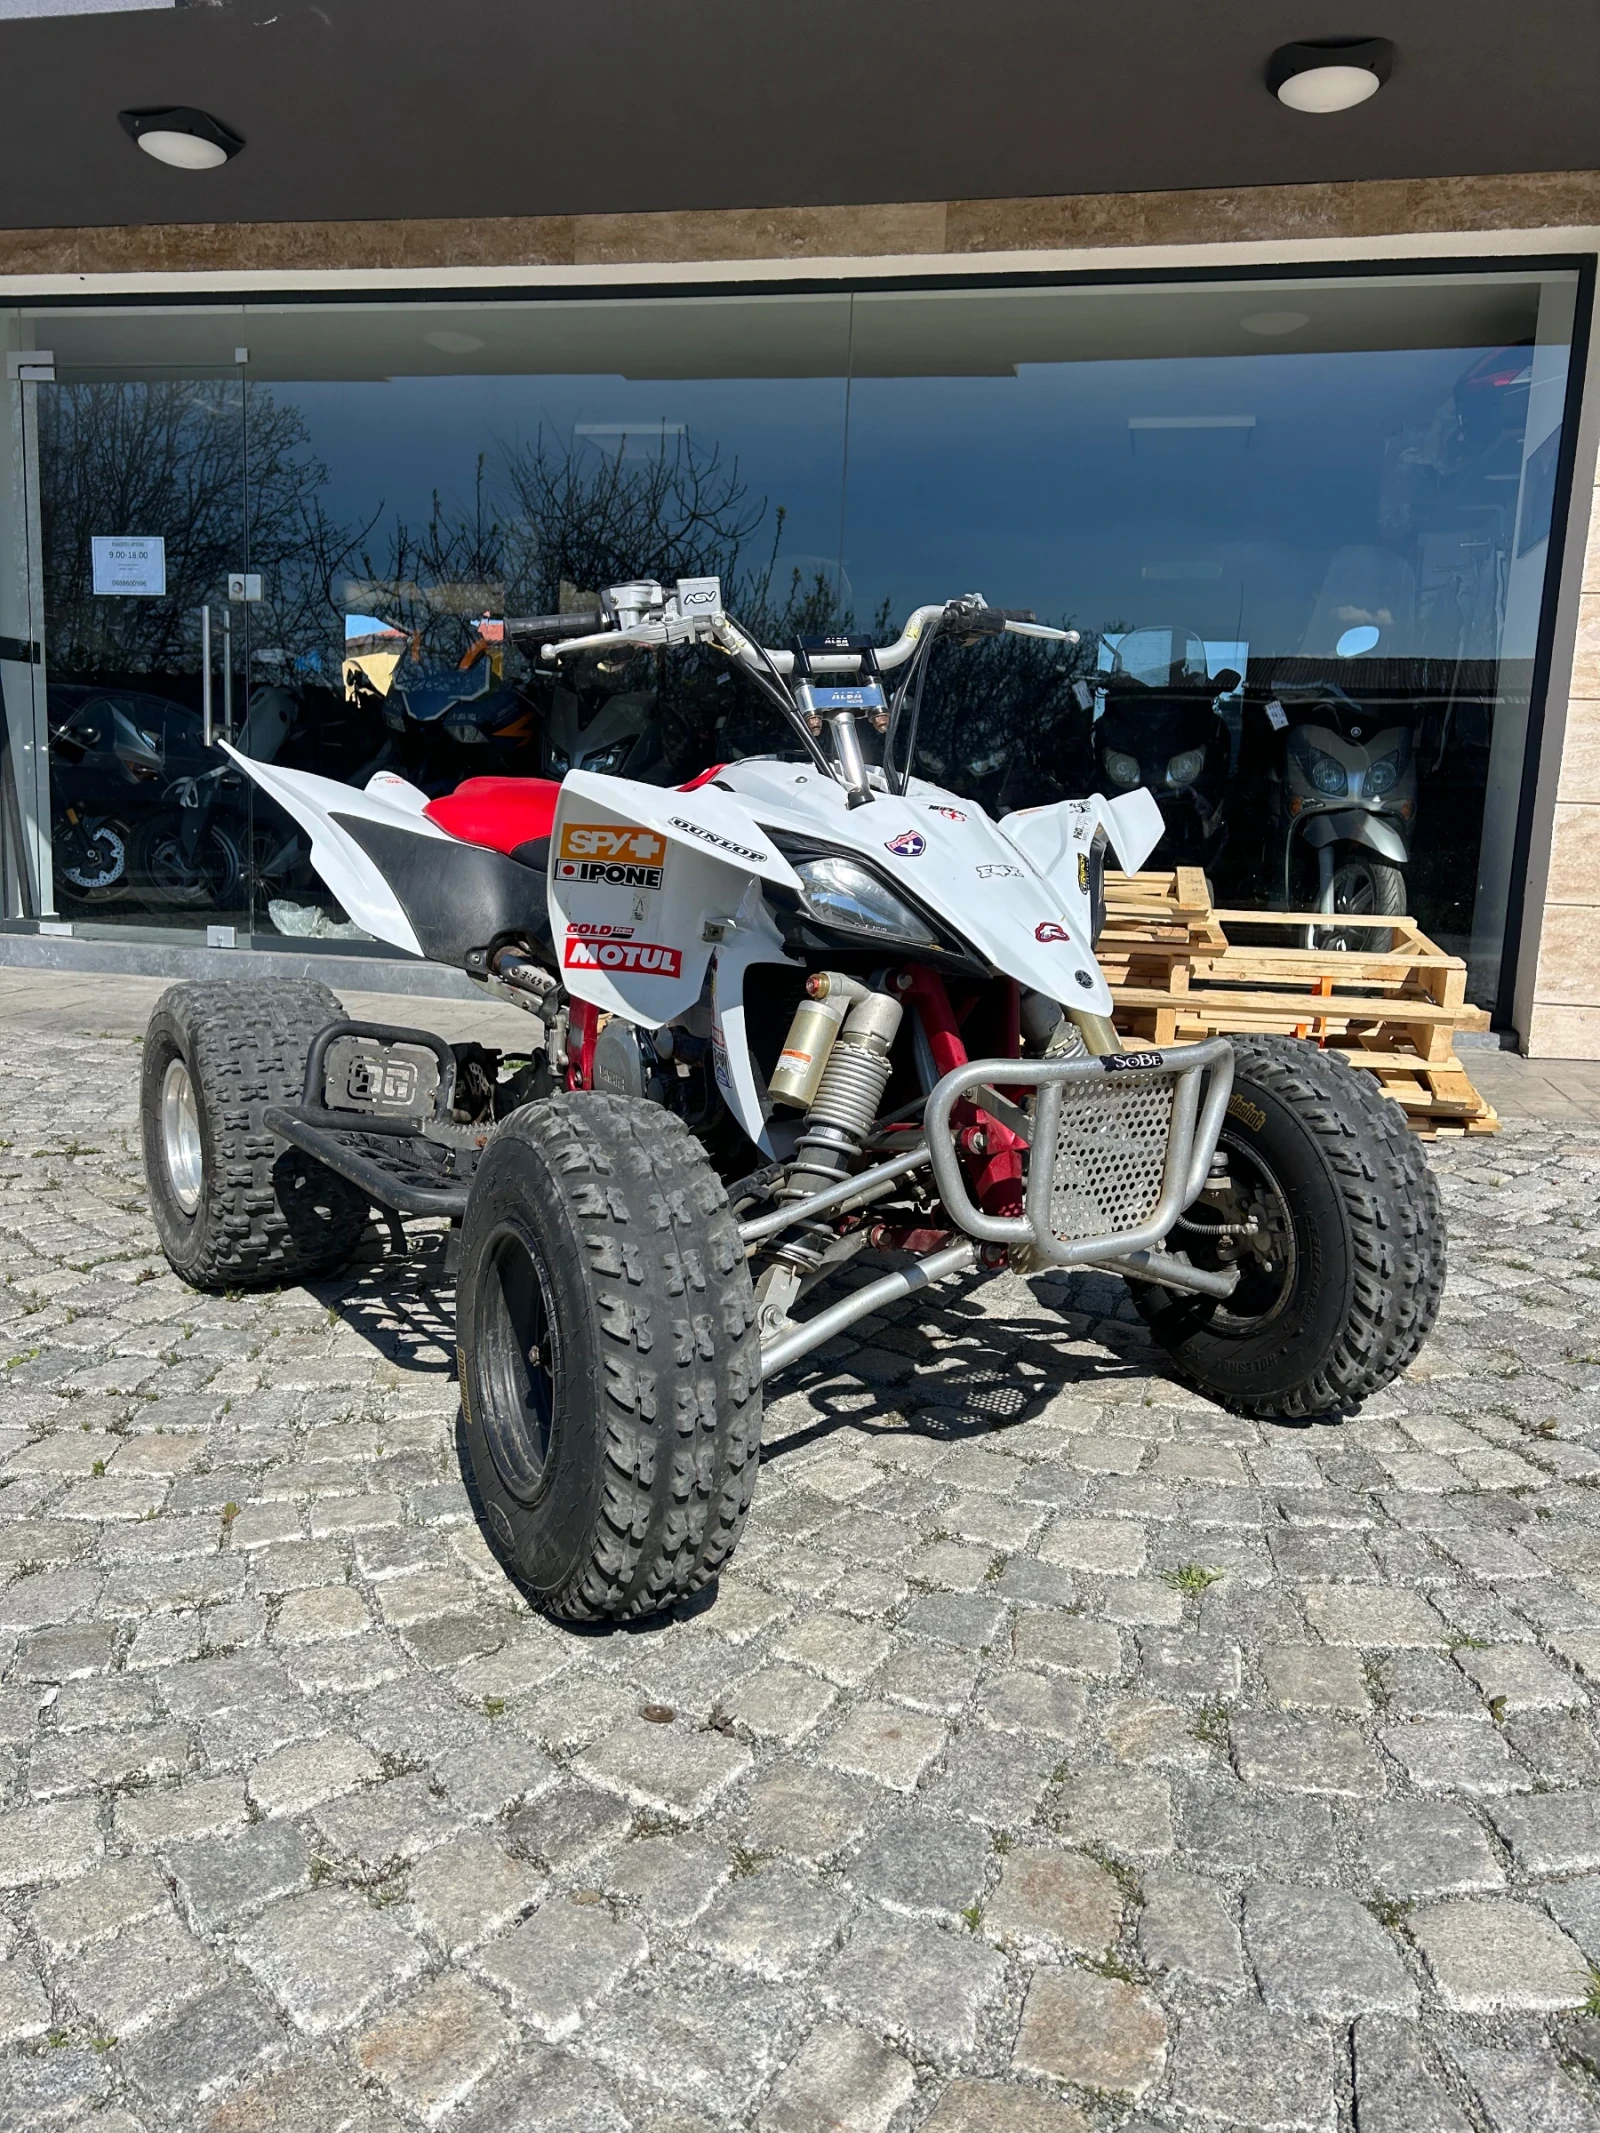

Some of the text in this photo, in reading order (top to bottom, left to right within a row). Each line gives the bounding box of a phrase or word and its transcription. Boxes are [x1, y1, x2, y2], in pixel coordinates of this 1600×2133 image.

[684, 590, 717, 605] ASV
[671, 817, 766, 862] DUNLOP
[580, 862, 661, 888] IPONE
[566, 922, 612, 936] GOLD
[569, 942, 676, 973] MOTUL
[1229, 1096, 1267, 1132] oleshot
